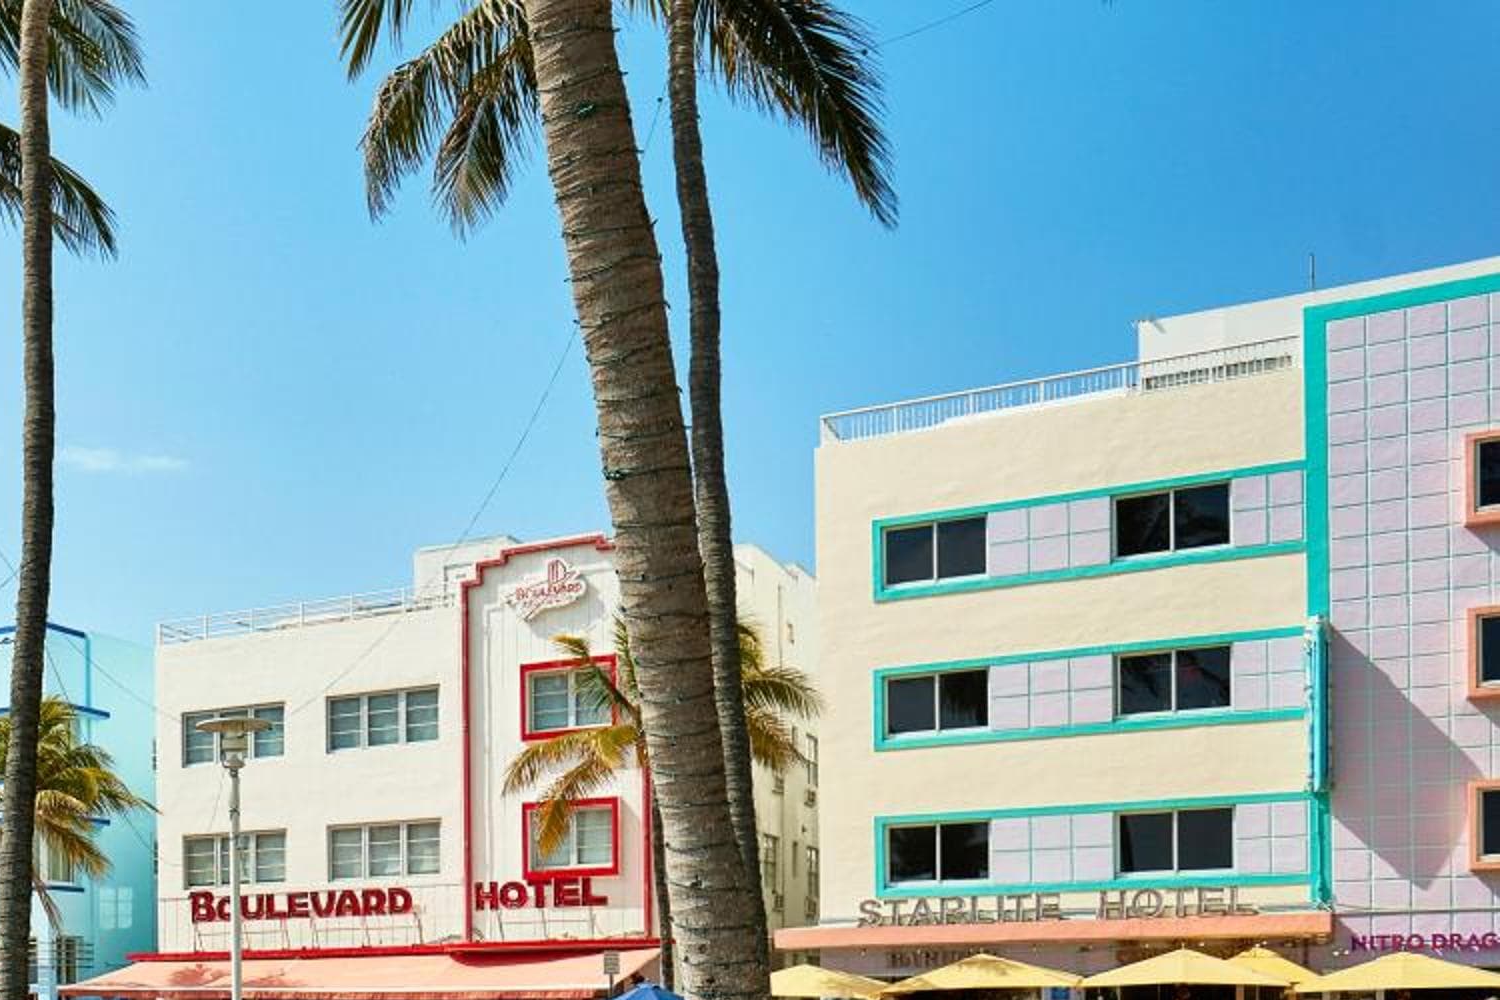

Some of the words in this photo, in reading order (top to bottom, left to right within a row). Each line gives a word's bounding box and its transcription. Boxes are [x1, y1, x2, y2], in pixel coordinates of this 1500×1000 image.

[474, 877, 608, 911] HOTEL
[857, 892, 1062, 928] STARLITE
[1098, 886, 1260, 921] HOTEL
[1351, 934, 1425, 952] NITRO
[1430, 932, 1500, 951] DRAG
